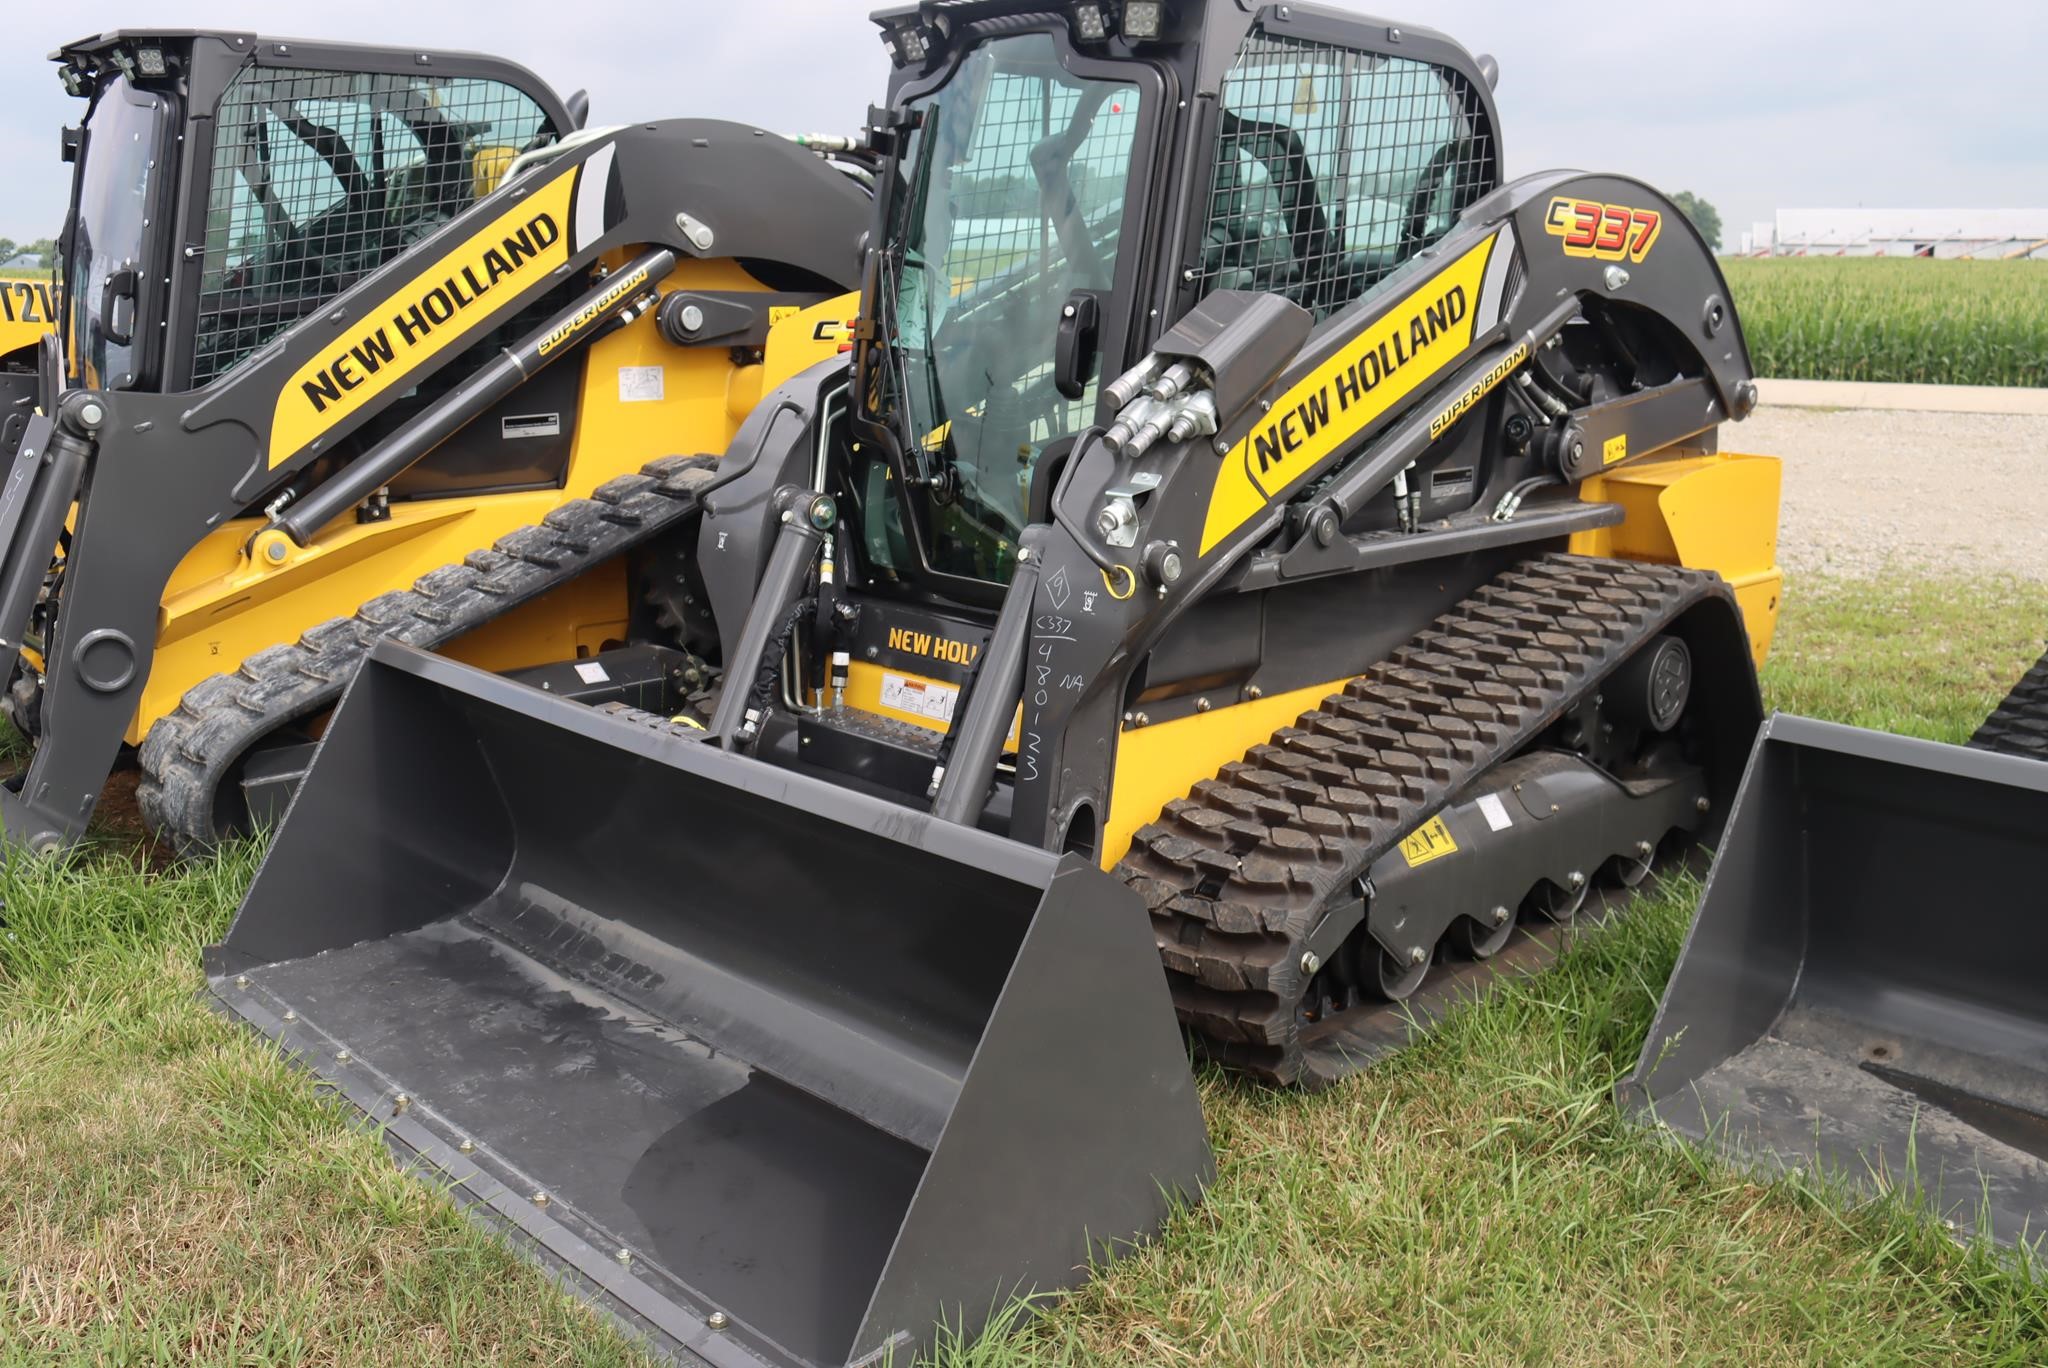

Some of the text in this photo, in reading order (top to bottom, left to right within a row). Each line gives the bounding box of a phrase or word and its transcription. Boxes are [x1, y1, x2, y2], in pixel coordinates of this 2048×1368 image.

[1547, 200, 1659, 255] C337
[301, 212, 559, 413] NEW HOLLAND
[540, 269, 645, 354] SUPER BOOM
[1253, 284, 1466, 474] NEW HOLLAND
[1431, 346, 1524, 436] SUPER BOOM
[888, 626, 931, 657] NEW
[1035, 615, 1072, 634] C337
